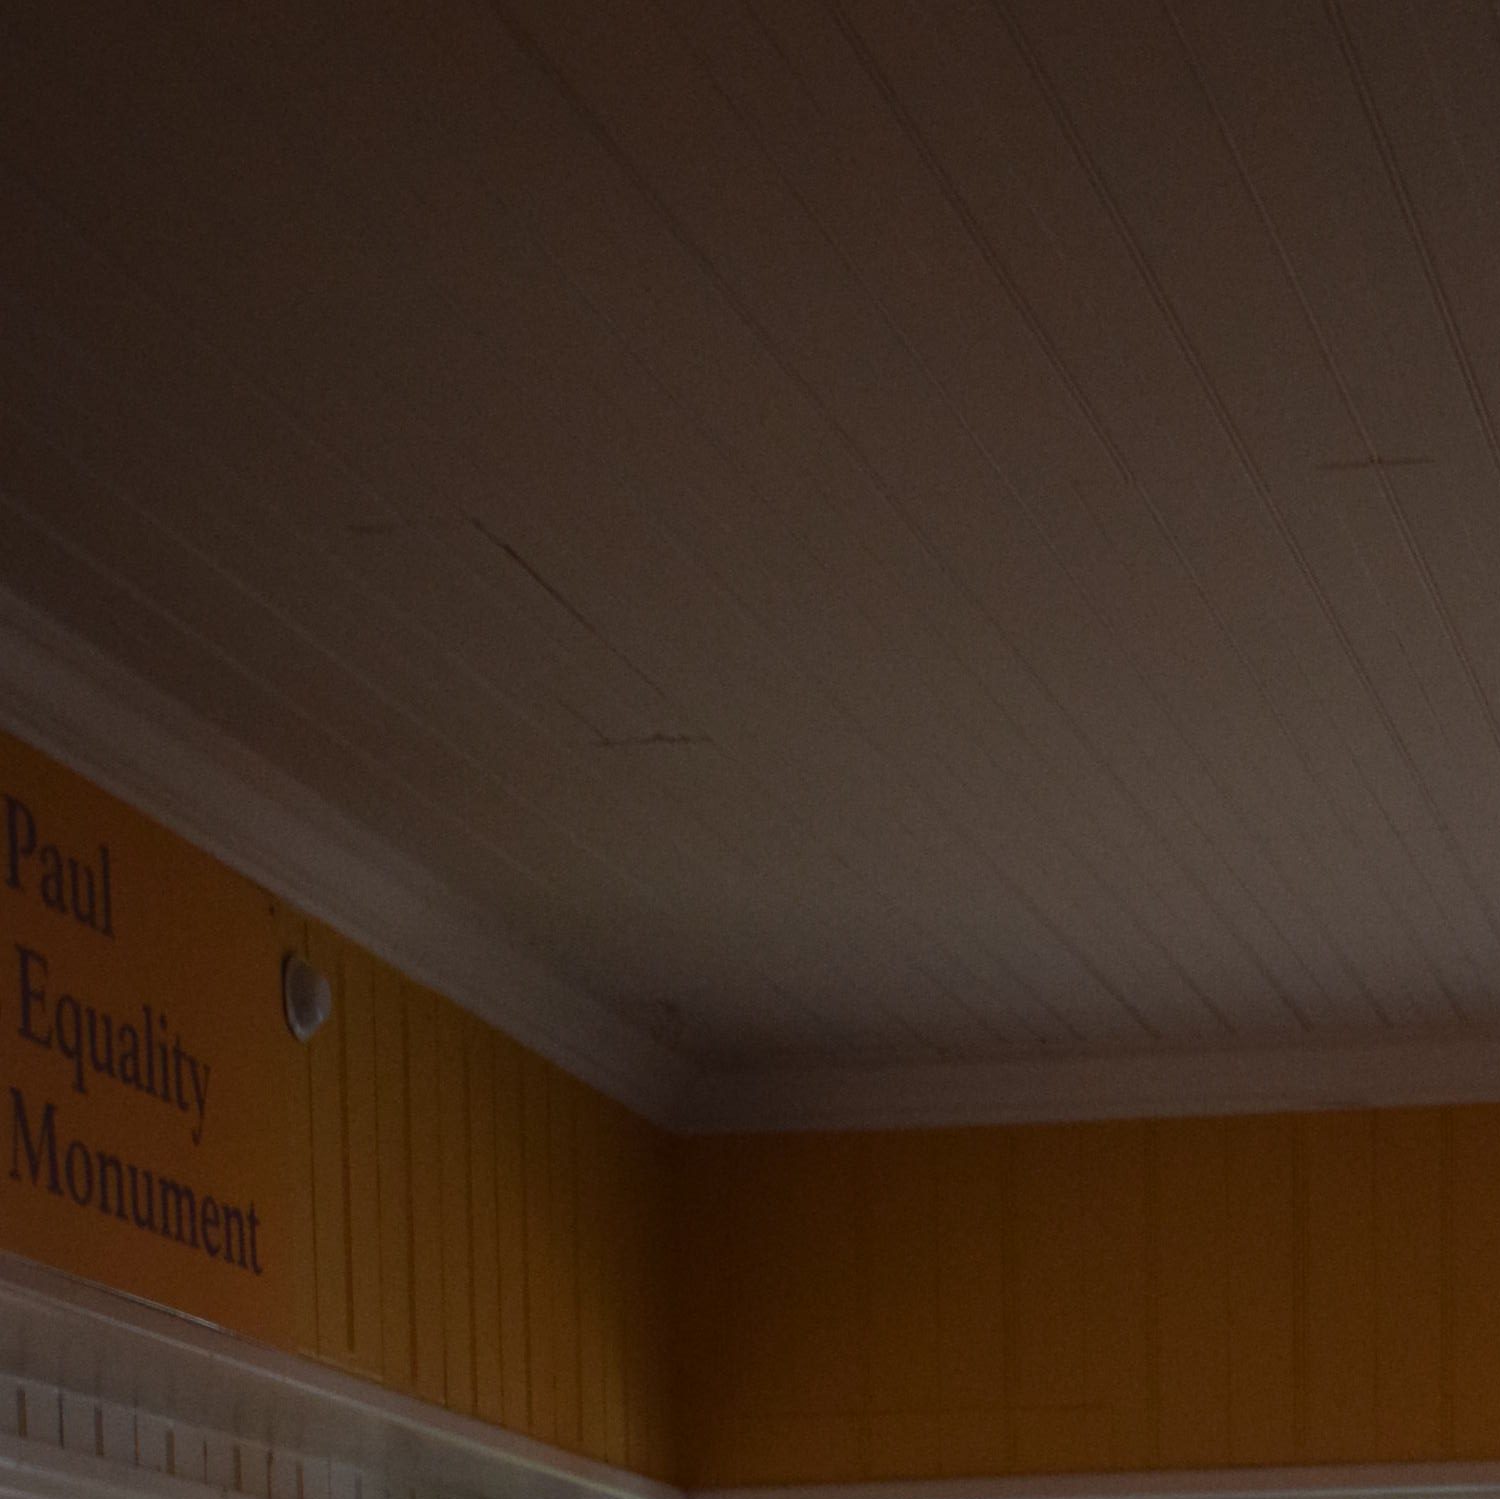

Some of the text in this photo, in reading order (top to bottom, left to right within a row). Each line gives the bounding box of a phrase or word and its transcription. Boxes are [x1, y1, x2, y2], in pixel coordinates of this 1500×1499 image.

[3, 792, 114, 938] Paul
[15, 944, 211, 1147] Equality
[9, 1085, 264, 1275] Monument
